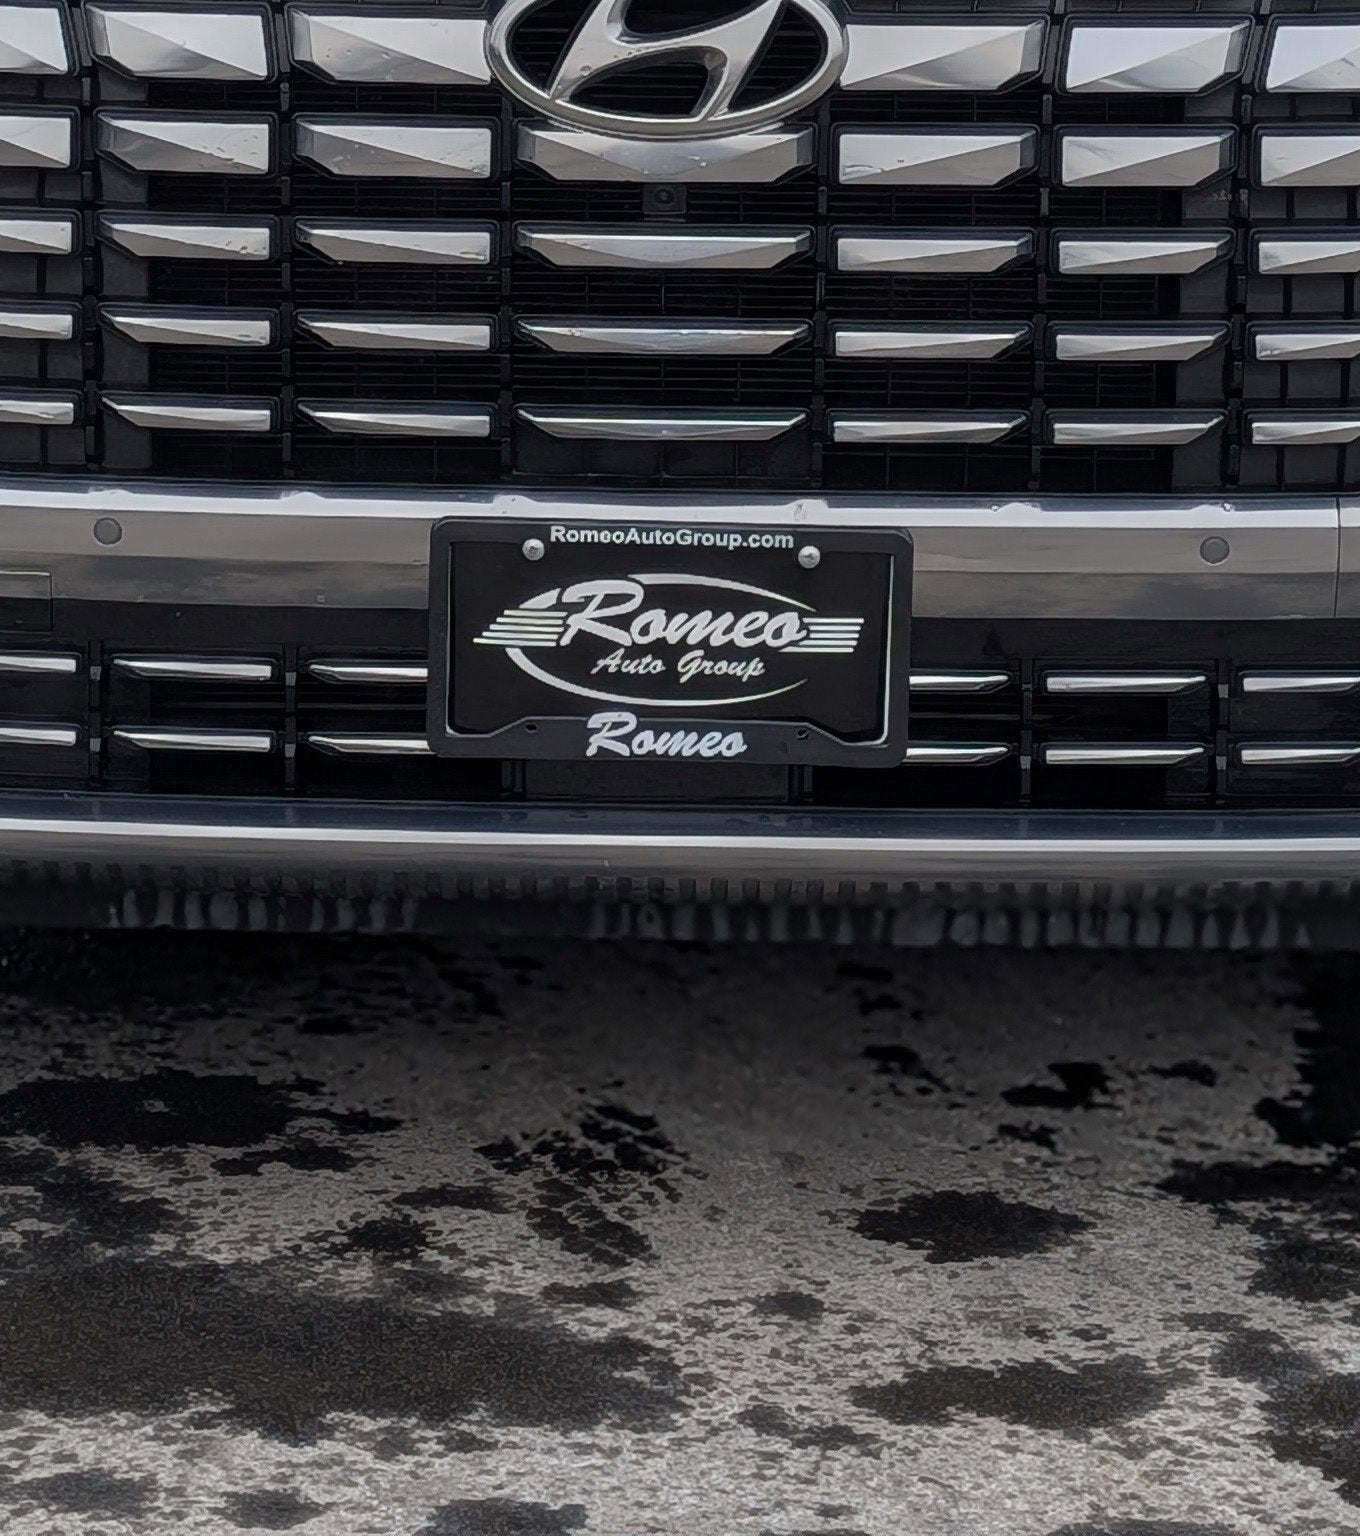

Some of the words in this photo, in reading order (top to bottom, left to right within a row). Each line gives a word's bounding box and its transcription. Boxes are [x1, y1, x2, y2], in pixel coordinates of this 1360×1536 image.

[550, 525, 794, 551] RomeoAutoGroup.com
[560, 579, 807, 647] Romeo
[591, 647, 665, 675] Auto
[677, 649, 765, 684] Group
[586, 711, 747, 757] Romeo
